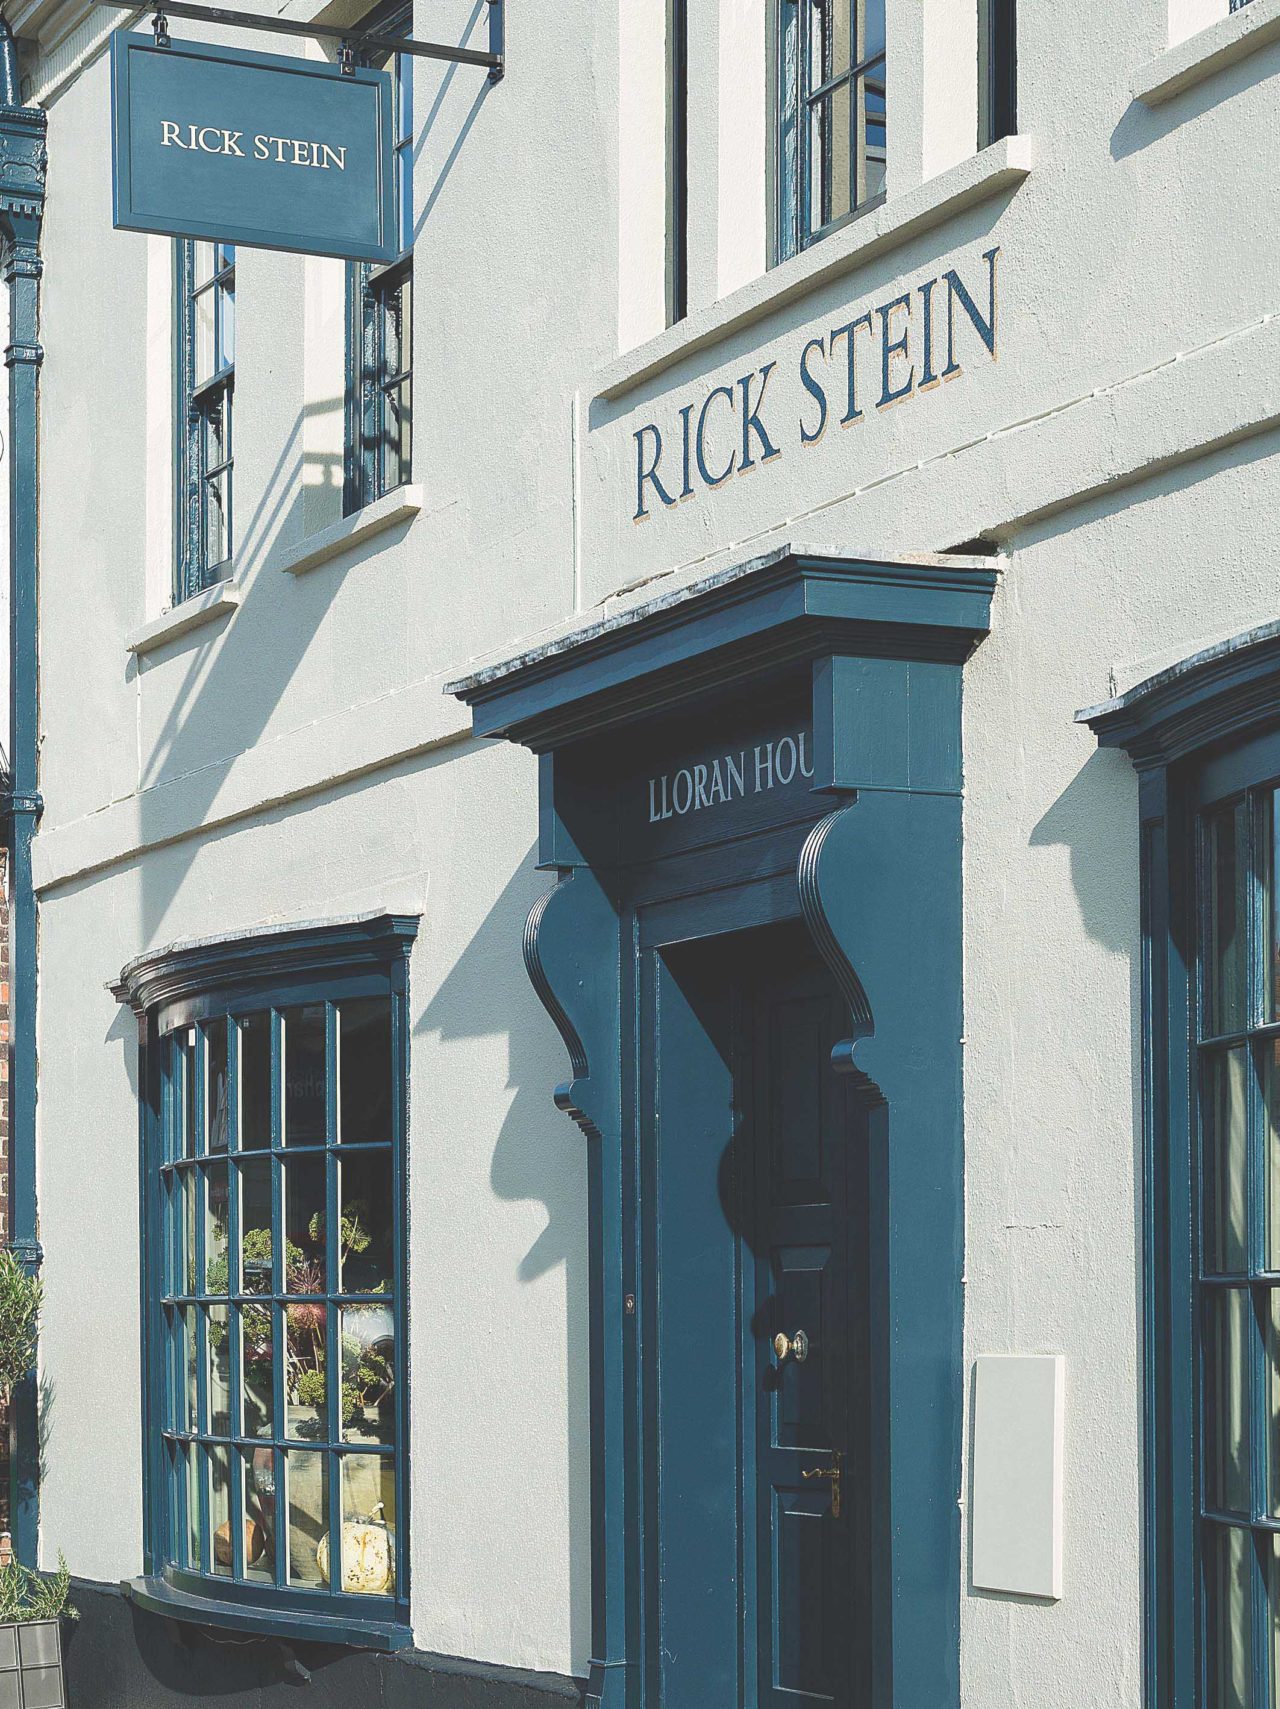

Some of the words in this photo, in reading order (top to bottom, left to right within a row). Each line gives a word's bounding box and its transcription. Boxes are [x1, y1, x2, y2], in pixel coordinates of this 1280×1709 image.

[160, 120, 245, 157] RICK
[253, 134, 347, 171] STEIN
[632, 360, 781, 525] RICK
[799, 246, 1001, 448] STEIN
[649, 751, 745, 822] LLORAN
